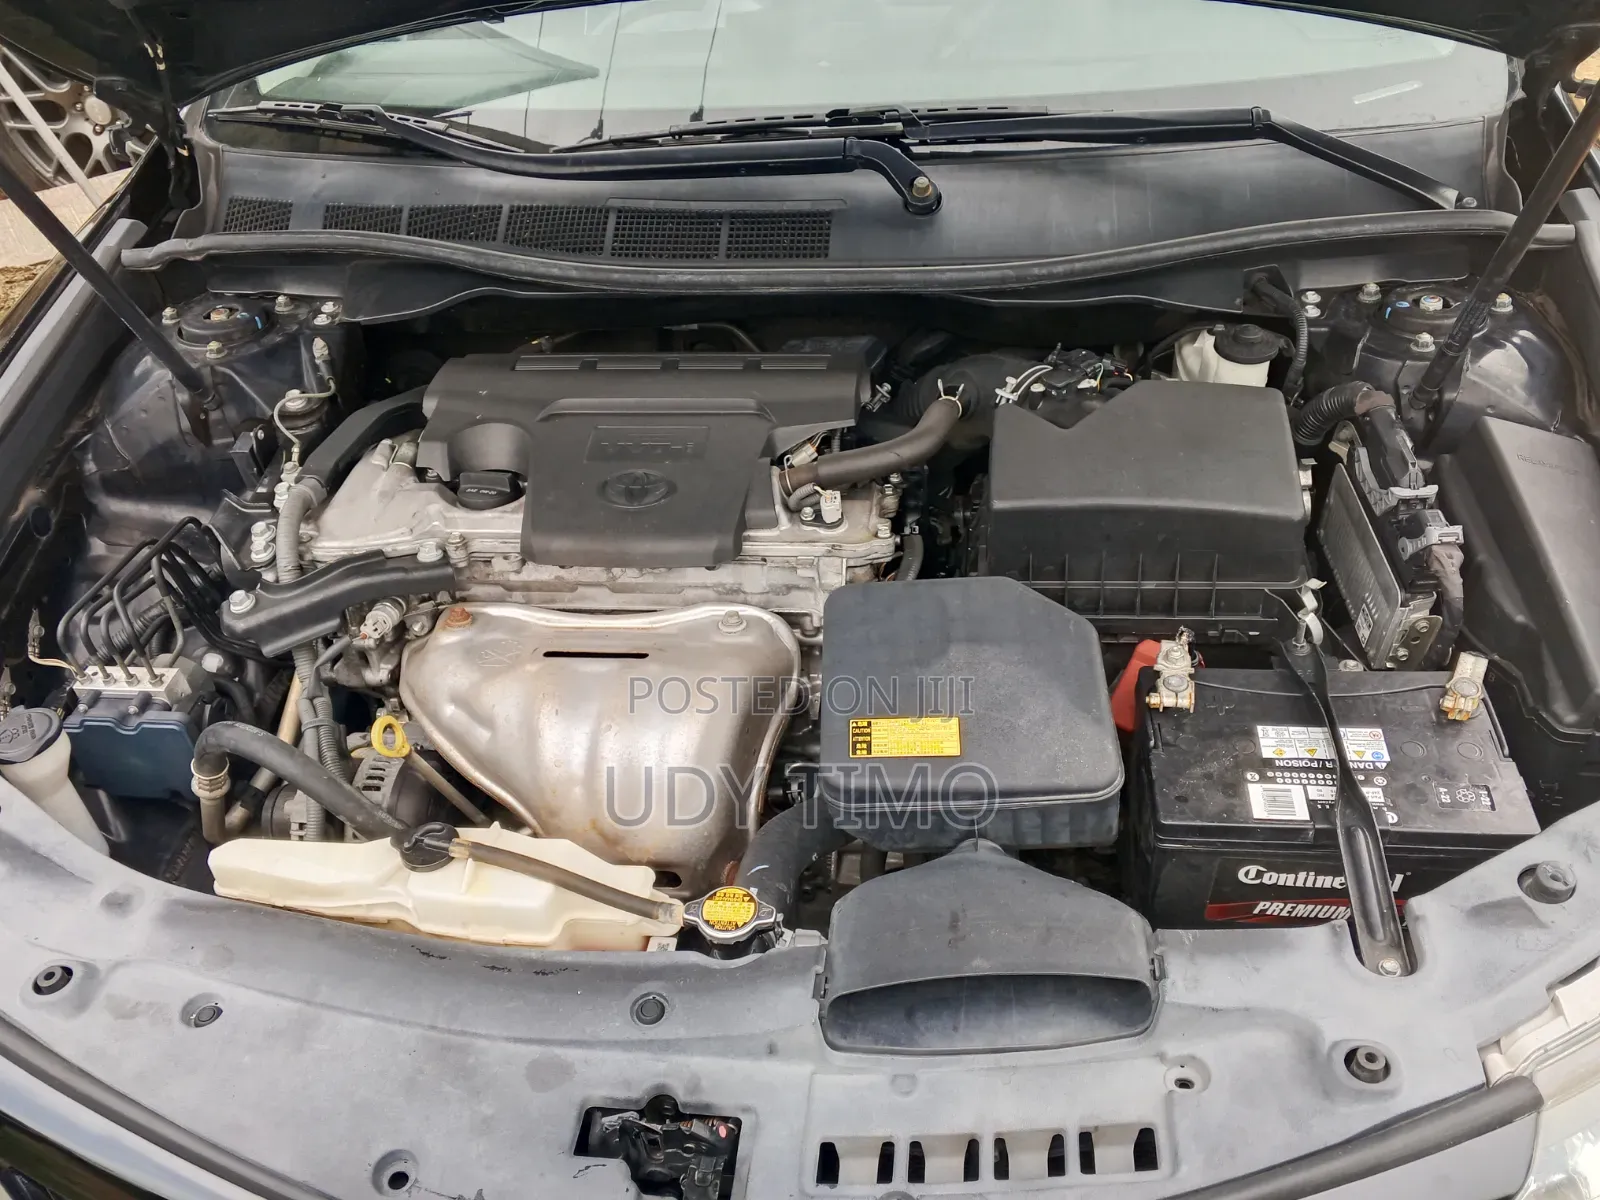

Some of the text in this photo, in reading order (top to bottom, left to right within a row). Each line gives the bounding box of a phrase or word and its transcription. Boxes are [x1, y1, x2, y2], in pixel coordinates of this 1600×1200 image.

[1275, 759, 1316, 768] POISON
[1326, 760, 1374, 770] DANR
[1237, 864, 1405, 892] Continel
[1253, 901, 1352, 920] PREMIUM
